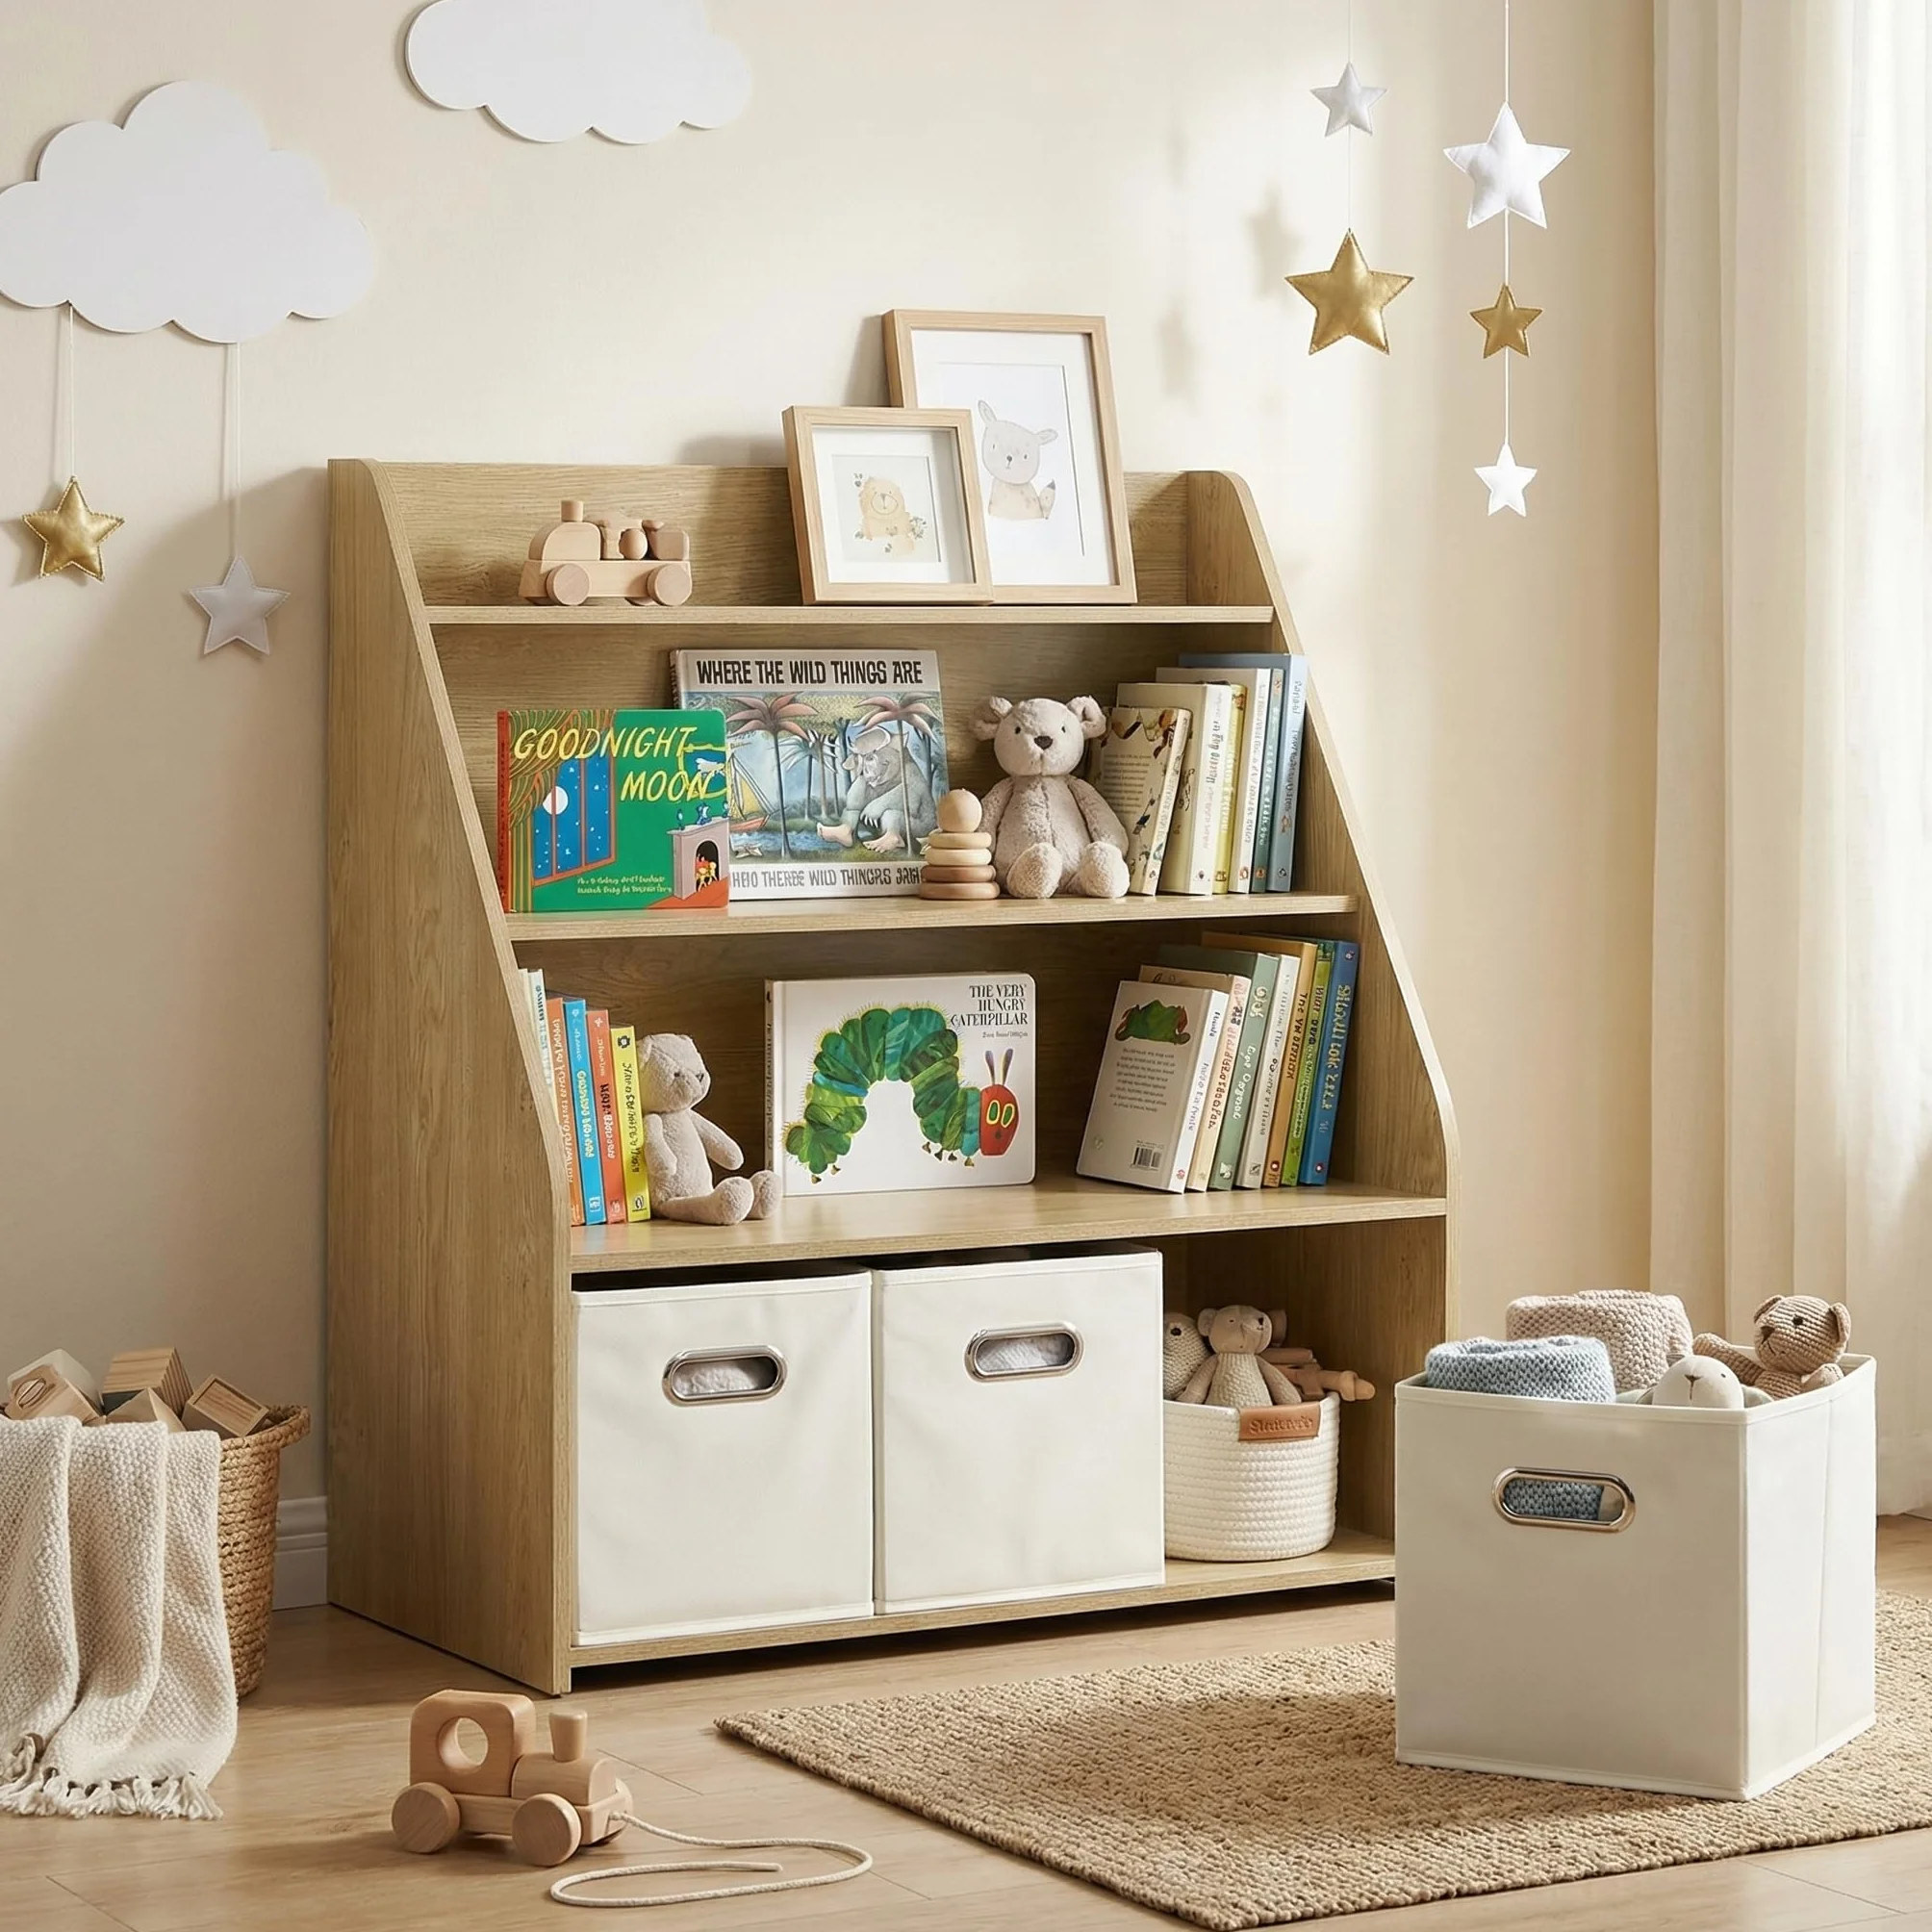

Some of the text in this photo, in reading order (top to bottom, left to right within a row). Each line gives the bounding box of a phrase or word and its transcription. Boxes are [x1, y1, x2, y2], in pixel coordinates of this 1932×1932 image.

[697, 660, 752, 684] WHERE
[755, 660, 784, 684] THE
[789, 660, 826, 684] WILD
[830, 660, 887, 684] THINGS
[892, 661, 923, 684] ARE
[514, 726, 698, 761] GOODNIGHT
[620, 770, 715, 802] MOON
[996, 983, 1027, 998] VERY
[978, 998, 1026, 1012] HUNGRY
